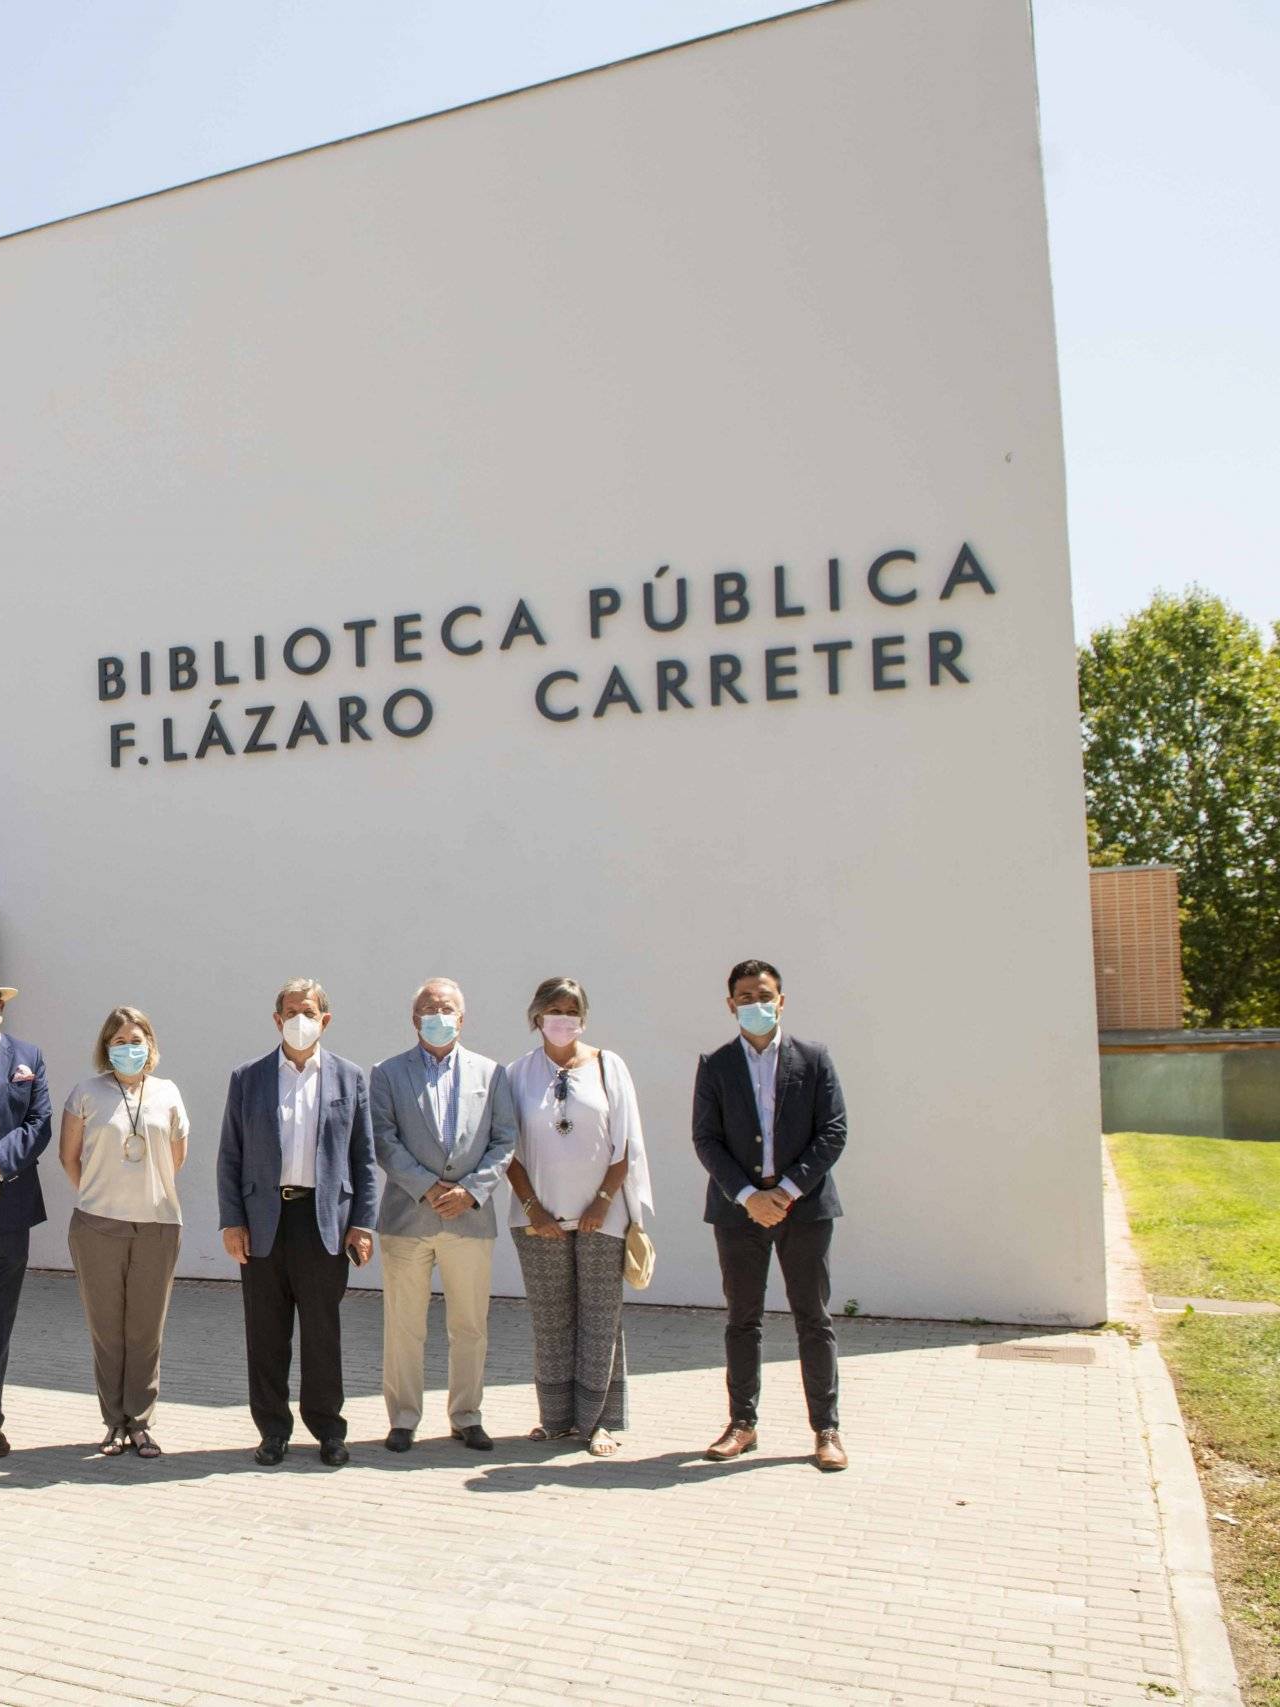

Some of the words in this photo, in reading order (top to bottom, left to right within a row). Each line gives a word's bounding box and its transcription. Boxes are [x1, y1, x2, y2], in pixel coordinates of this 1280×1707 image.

[97, 598, 547, 702] BIBLIOTECA
[589, 541, 996, 639] PÚBLICA
[535, 630, 970, 723] CARRETER
